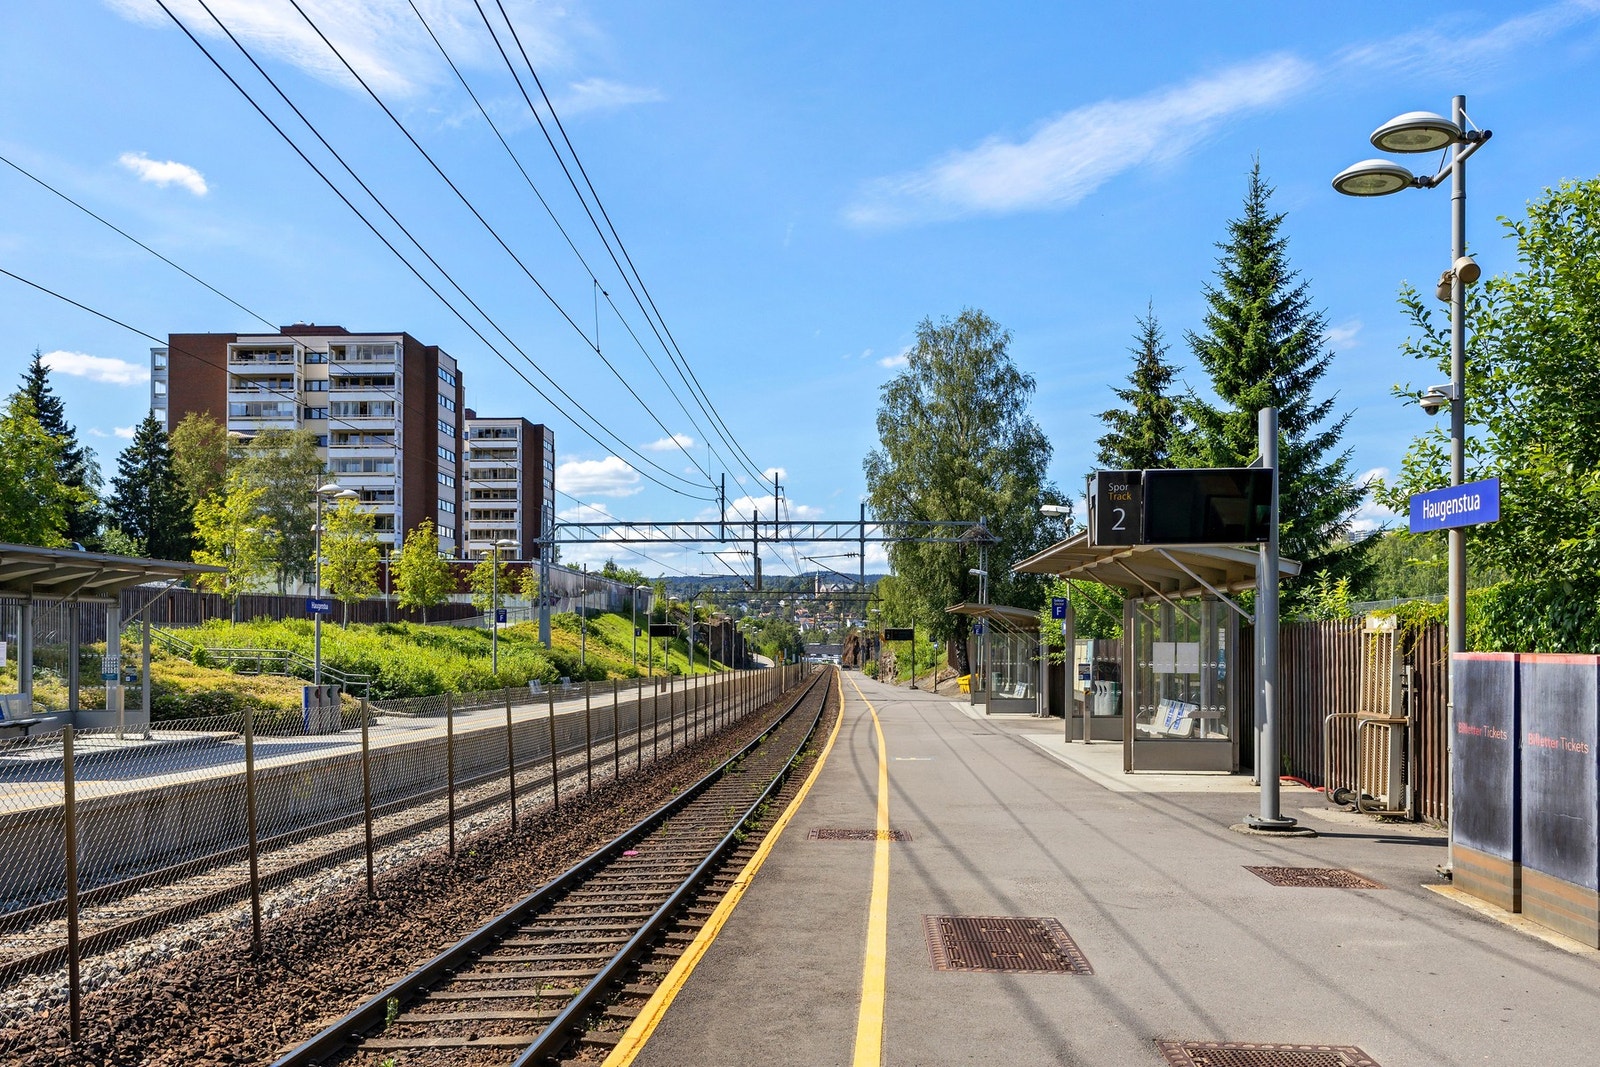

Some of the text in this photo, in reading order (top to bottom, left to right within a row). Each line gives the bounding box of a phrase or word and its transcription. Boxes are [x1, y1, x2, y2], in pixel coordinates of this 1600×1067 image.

[1108, 483, 1128, 492] Spor
[1108, 491, 1132, 501] Track
[1422, 494, 1480, 521] Haugenstua
[1111, 508, 1126, 531] 2
[1056, 606, 1062, 616] F
[1457, 721, 1508, 741] Billetter Tickets
[1527, 732, 1589, 754] Billetter Tickets
